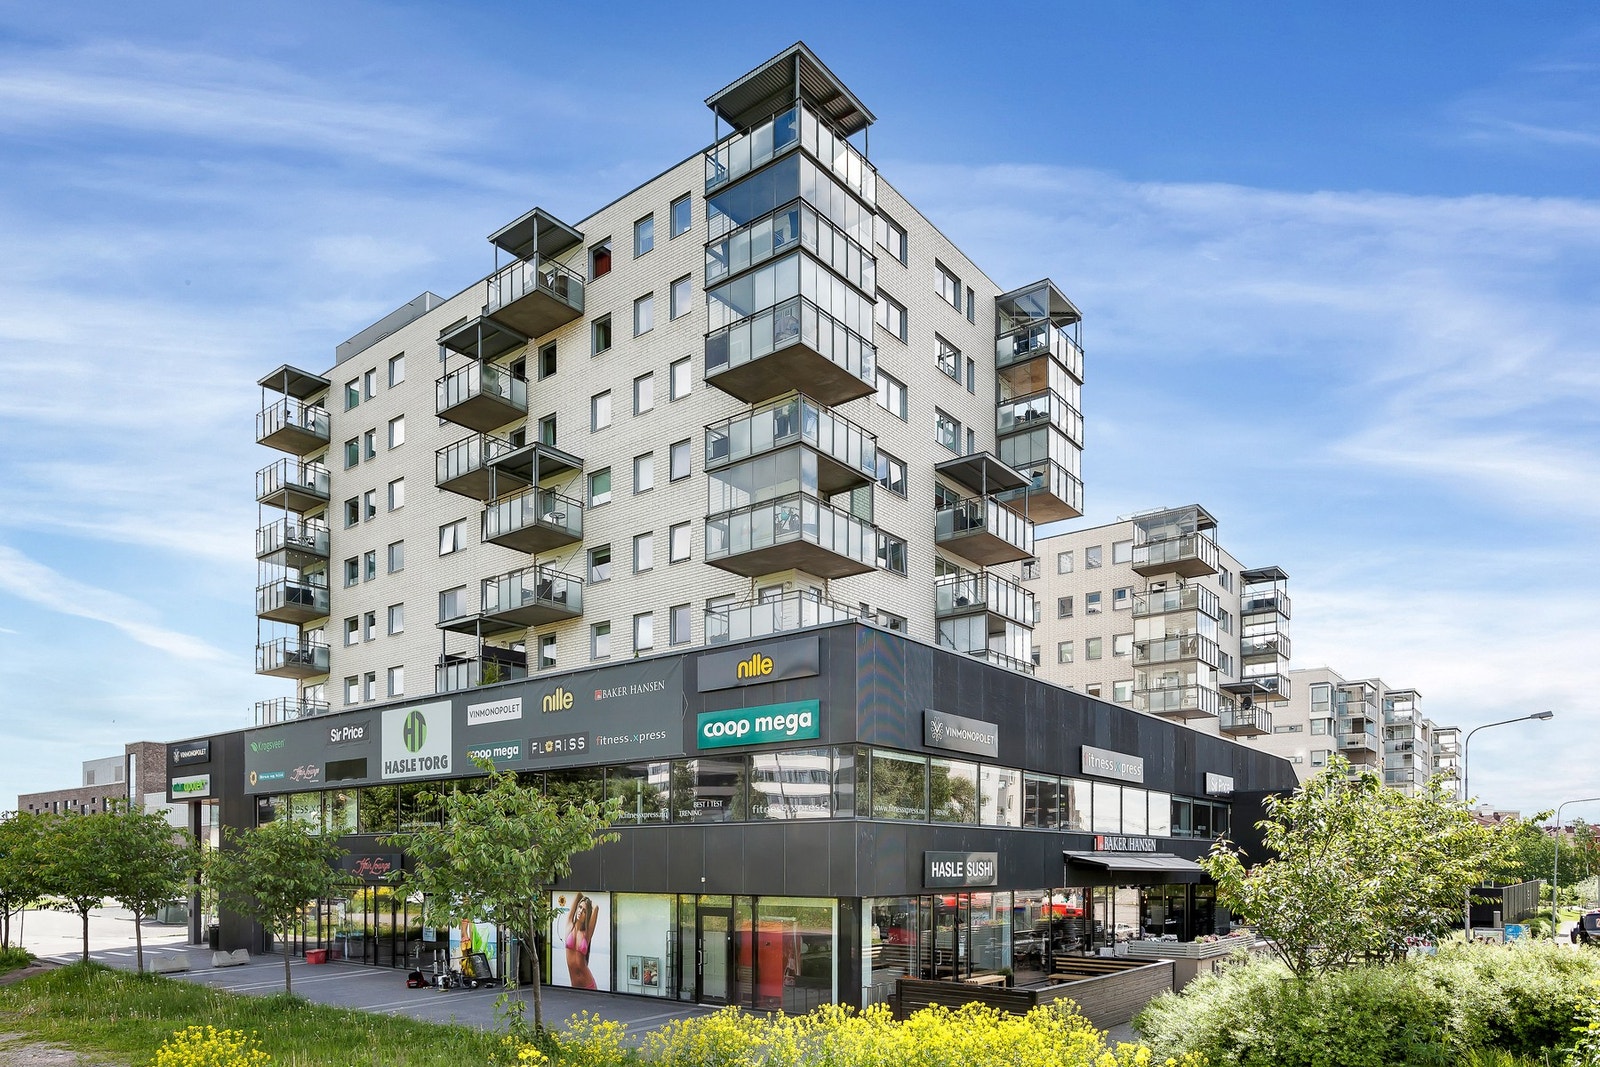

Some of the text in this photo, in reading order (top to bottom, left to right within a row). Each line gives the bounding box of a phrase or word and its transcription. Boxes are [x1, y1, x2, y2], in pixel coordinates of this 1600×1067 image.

[737, 653, 774, 679] nille
[602, 680, 665, 699] BAKER HANSEN
[542, 687, 574, 713] nille
[469, 703, 520, 718] VINMONOPOLET
[704, 712, 812, 738] coop mega
[330, 726, 364, 742] Sir Price
[596, 730, 666, 746] fitness.xpress
[945, 726, 995, 745] VINMONOPOLET
[180, 748, 207, 758] VINMONOPOLET
[493, 745, 519, 759] mega
[384, 754, 449, 775] HASLE TORG
[1104, 836, 1157, 852] BAKER HANSEN
[931, 861, 993, 878] HASLE SUSHI
